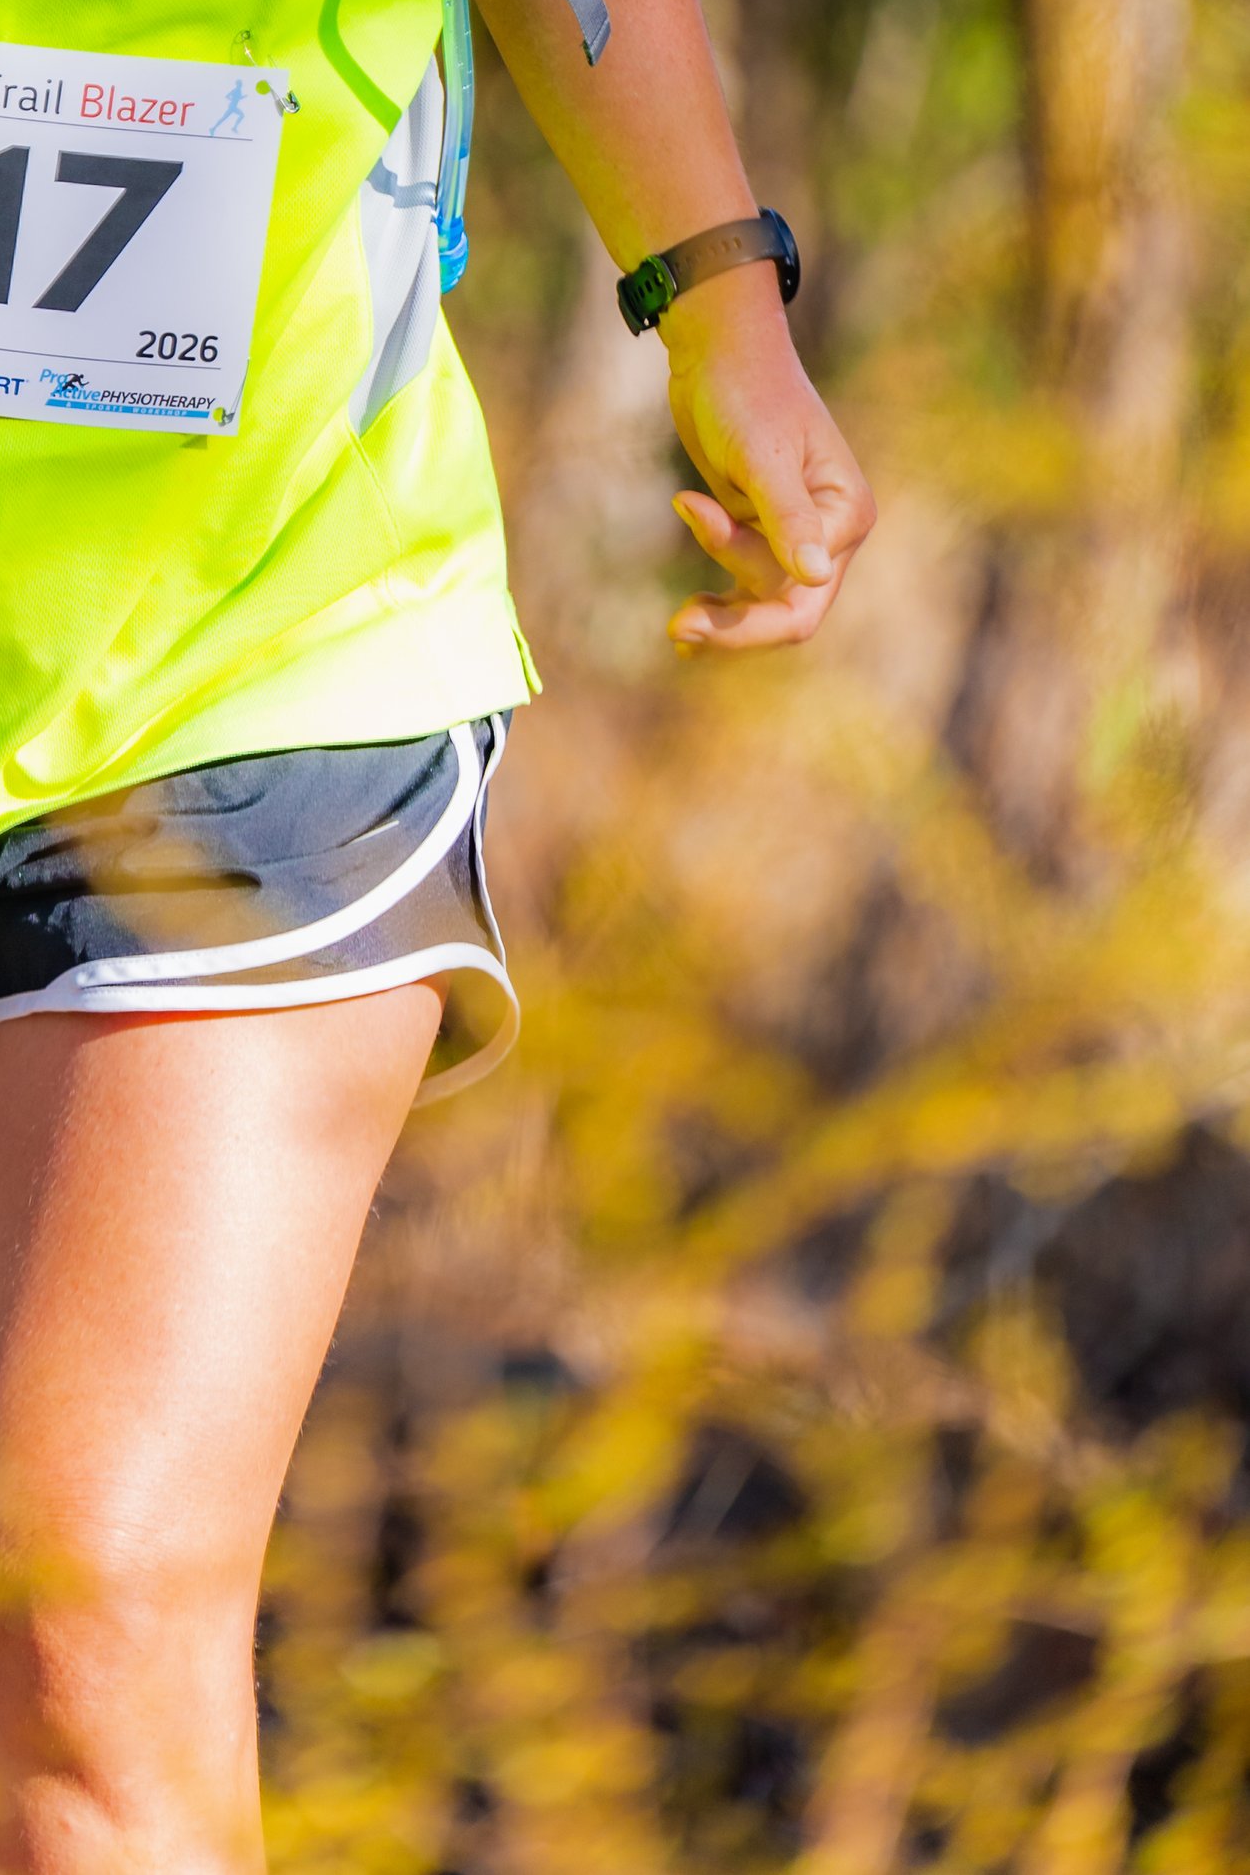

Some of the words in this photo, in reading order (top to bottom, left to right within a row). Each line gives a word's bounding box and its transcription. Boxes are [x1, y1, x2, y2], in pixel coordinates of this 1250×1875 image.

[80, 82, 195, 126] Blazer
[136, 330, 219, 362] 2026
[85, 403, 123, 413] SPORTS
[133, 406, 188, 417] WORKSHOP
